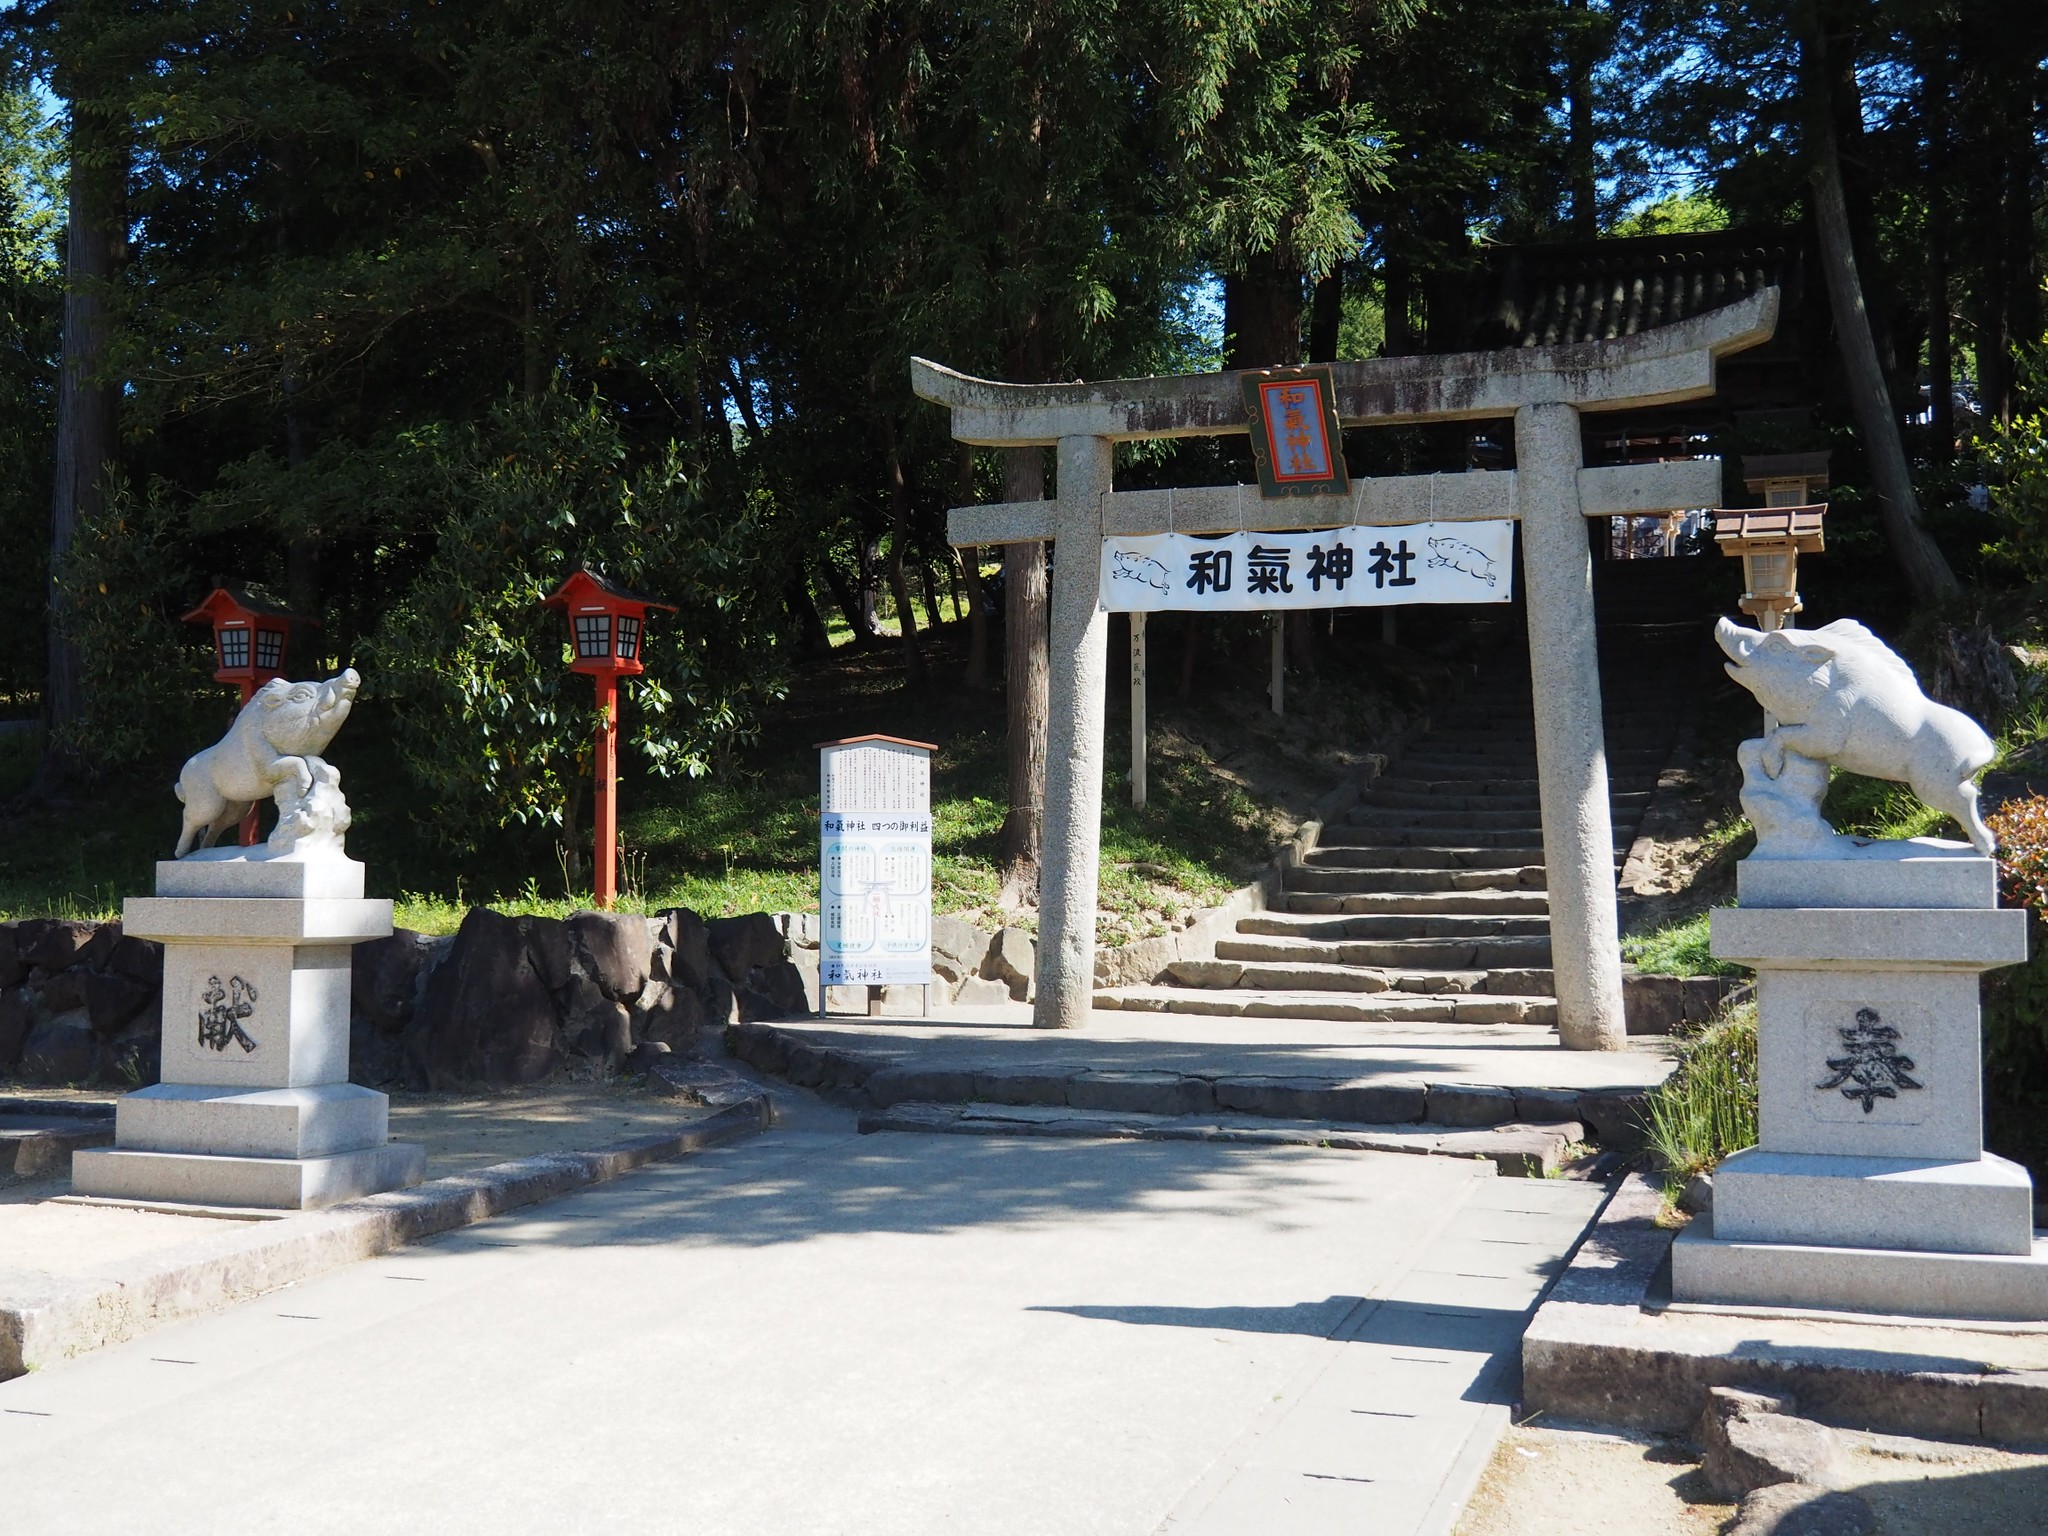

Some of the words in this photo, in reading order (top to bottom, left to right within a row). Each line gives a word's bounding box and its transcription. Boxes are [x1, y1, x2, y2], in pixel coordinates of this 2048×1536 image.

[1186, 540, 1416, 595] 和氣神社
[825, 820, 866, 832] 和氣神社
[872, 820, 929, 832] 四つの御利益
[1814, 1007, 1923, 1114] 奉
